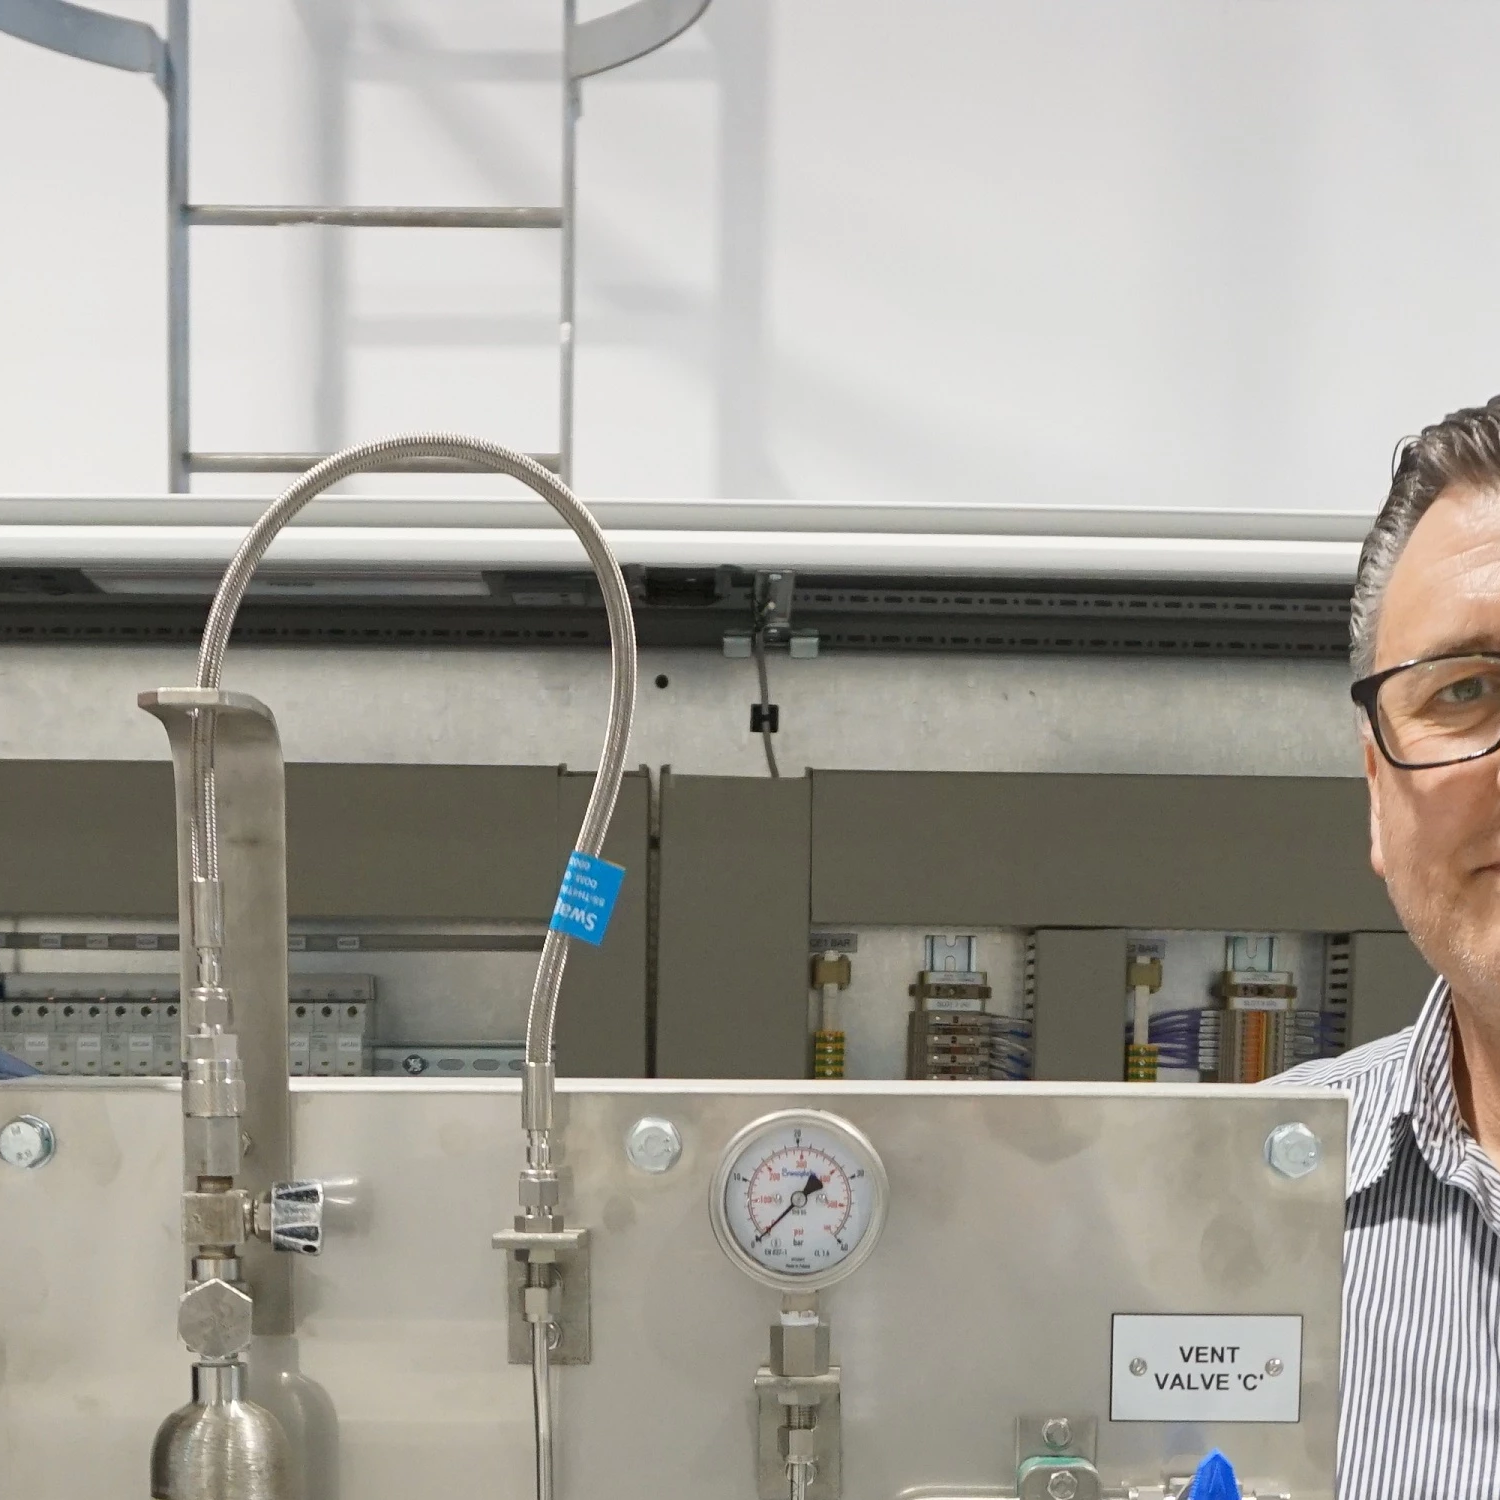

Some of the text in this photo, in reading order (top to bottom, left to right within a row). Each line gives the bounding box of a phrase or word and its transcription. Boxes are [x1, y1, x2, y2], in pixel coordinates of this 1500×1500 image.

[793, 1238, 804, 1246] bar
[1179, 1346, 1240, 1363] VENT
[1154, 1373, 1264, 1391] VALVE 'C'
